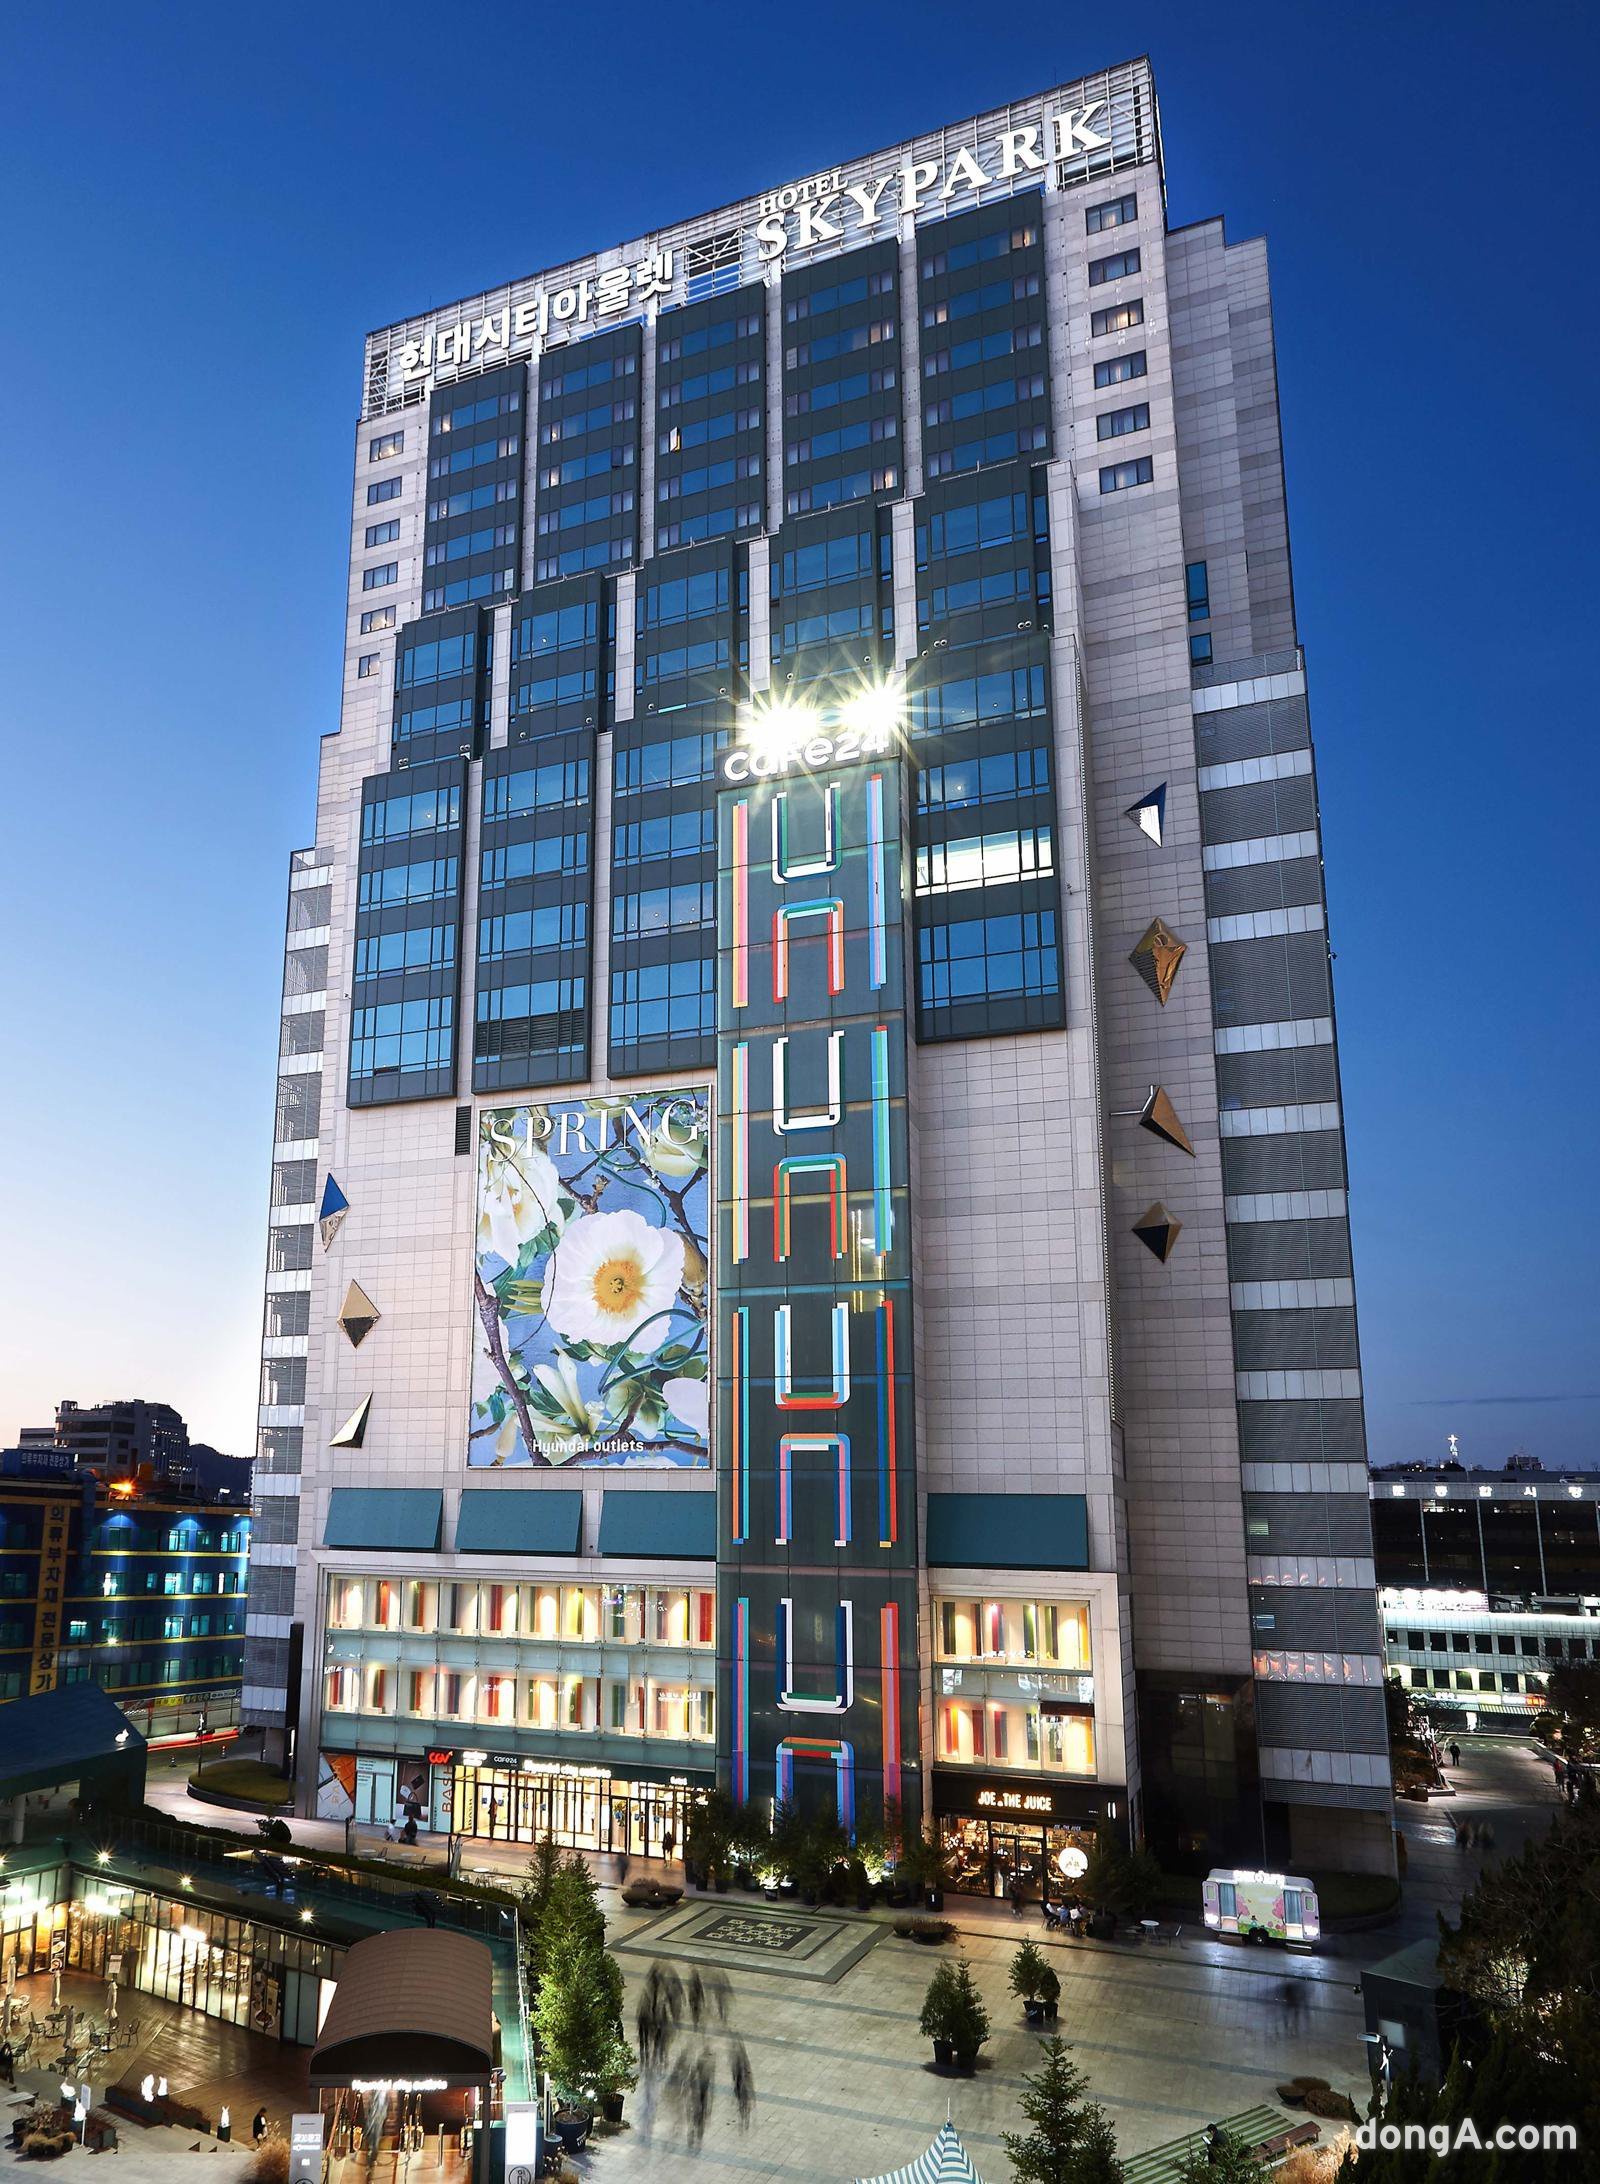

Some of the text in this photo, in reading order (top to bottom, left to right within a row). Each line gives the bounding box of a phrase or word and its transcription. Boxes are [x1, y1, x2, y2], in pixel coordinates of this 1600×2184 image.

[756, 99, 1112, 262] SKYPARK
[758, 170, 849, 215] HOTEL
[398, 249, 674, 381] 현대시티아울렛
[488, 1098, 701, 1163] SPRING
[532, 1438, 645, 1458] Hyundai outlets
[428, 1751, 452, 1765] CGV
[978, 1791, 996, 1806] JOE
[1003, 1792, 1022, 1809] THE
[1023, 1795, 1052, 1811] JUICE
